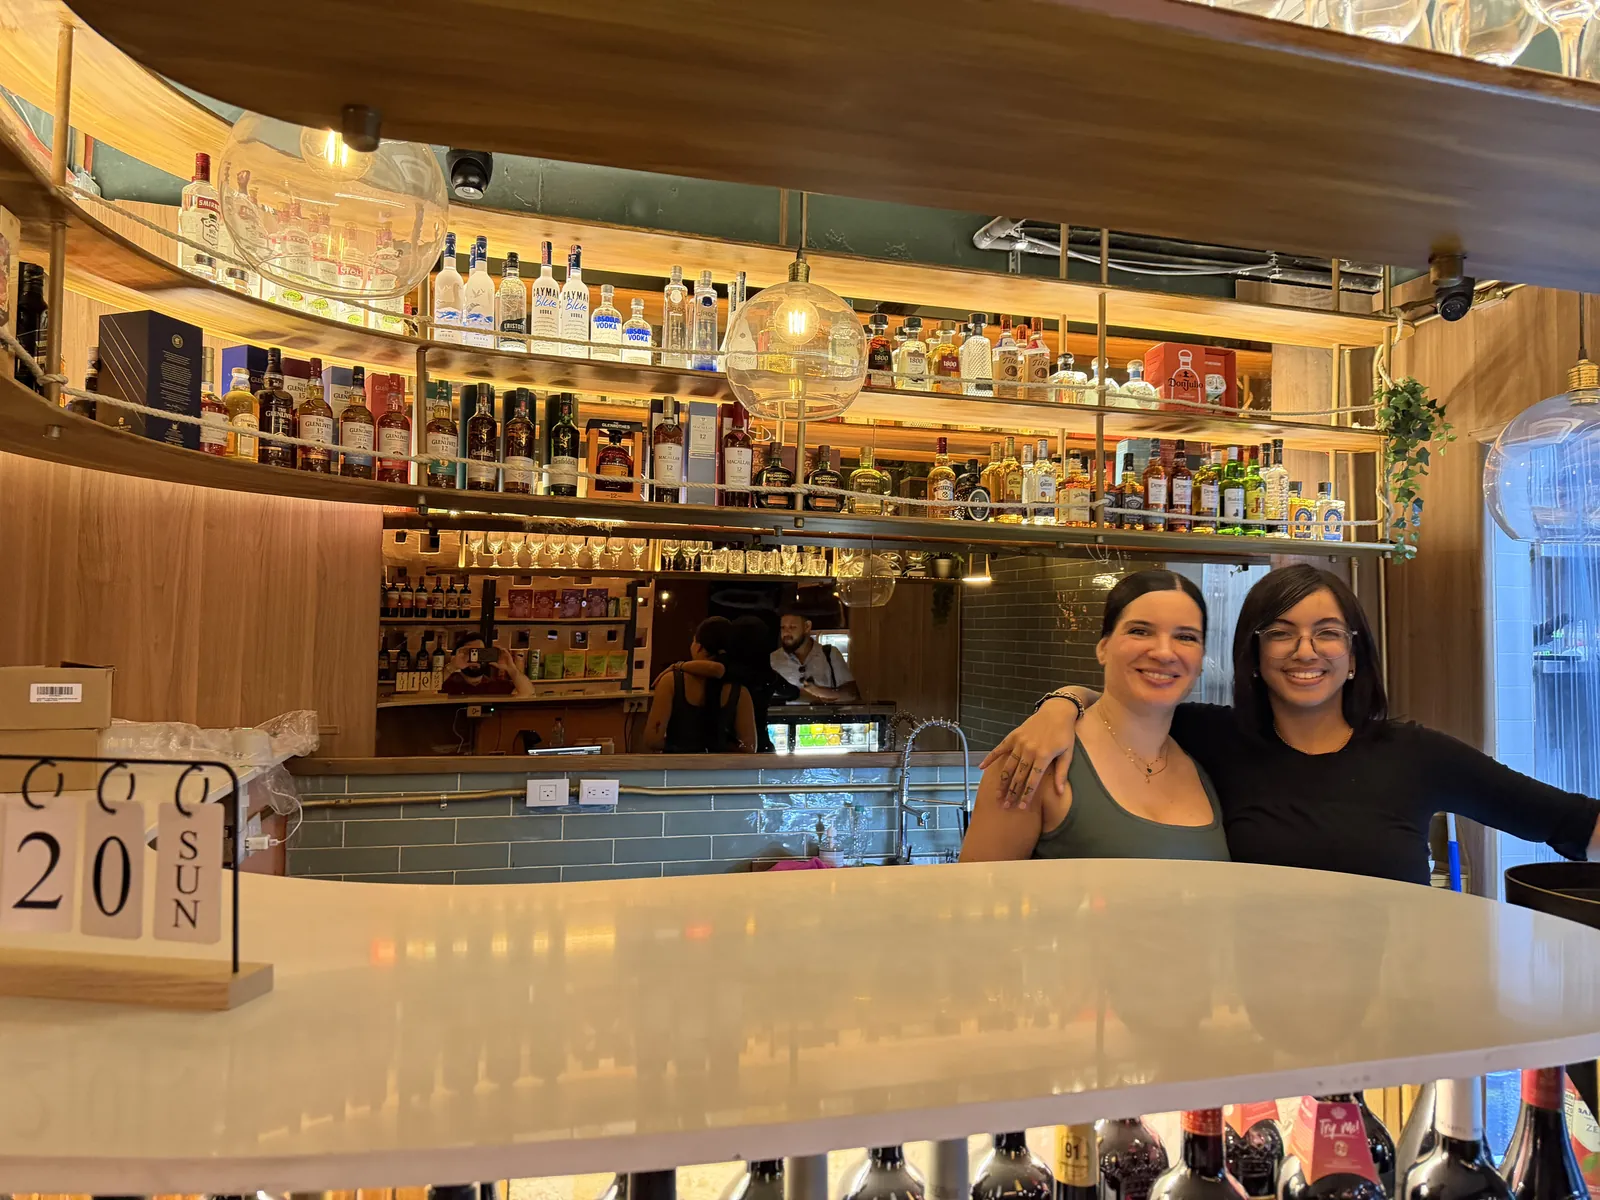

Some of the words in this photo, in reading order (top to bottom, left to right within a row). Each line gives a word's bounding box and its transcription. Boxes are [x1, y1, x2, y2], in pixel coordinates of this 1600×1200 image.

[596, 322, 618, 330] VODKA
[628, 334, 649, 343] VODKA
[943, 360, 957, 368] 1800
[172, 830, 203, 930] SUN
[1319, 1119, 1337, 1139] Try
[1065, 1142, 1080, 1160] 91
